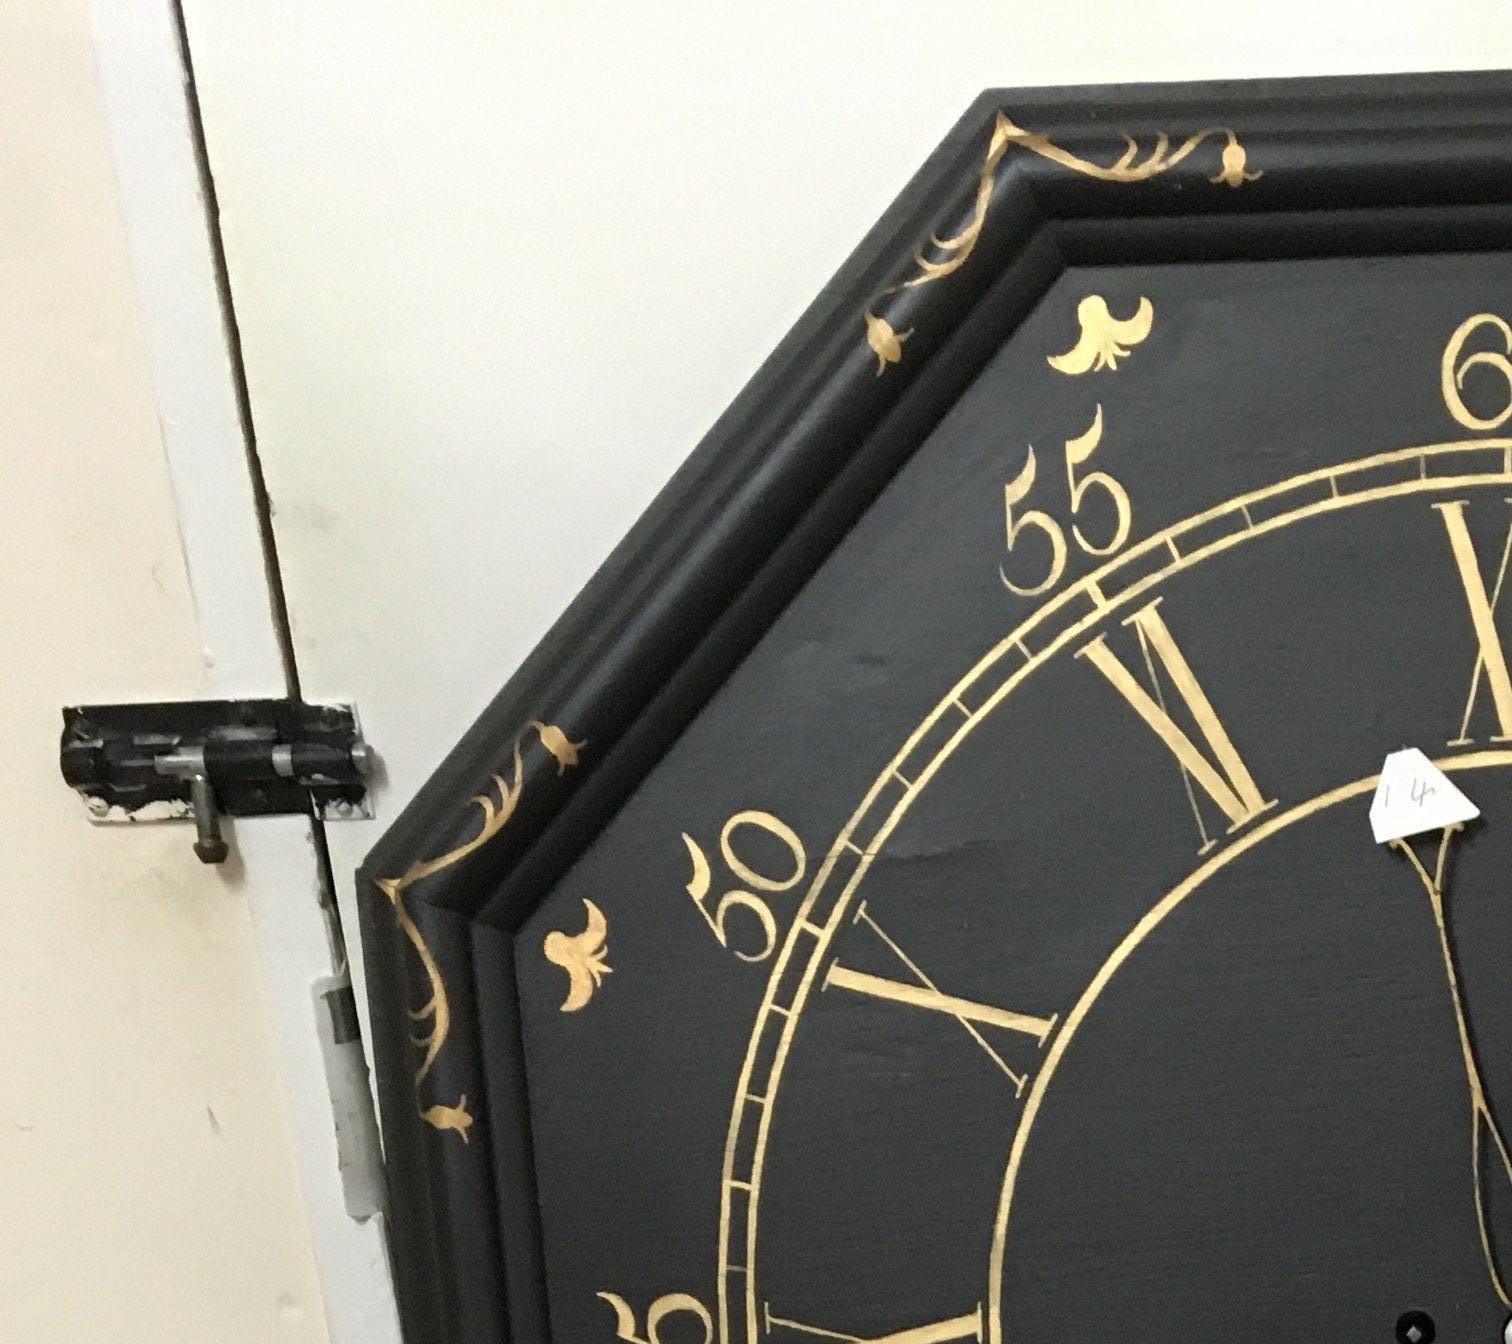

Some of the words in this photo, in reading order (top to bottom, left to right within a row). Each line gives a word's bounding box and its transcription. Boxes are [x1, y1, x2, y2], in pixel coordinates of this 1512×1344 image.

[1000, 405, 1132, 596] 55
[1074, 597, 1278, 853] XI
[682, 810, 806, 962] 50
[822, 900, 1058, 1098] X
